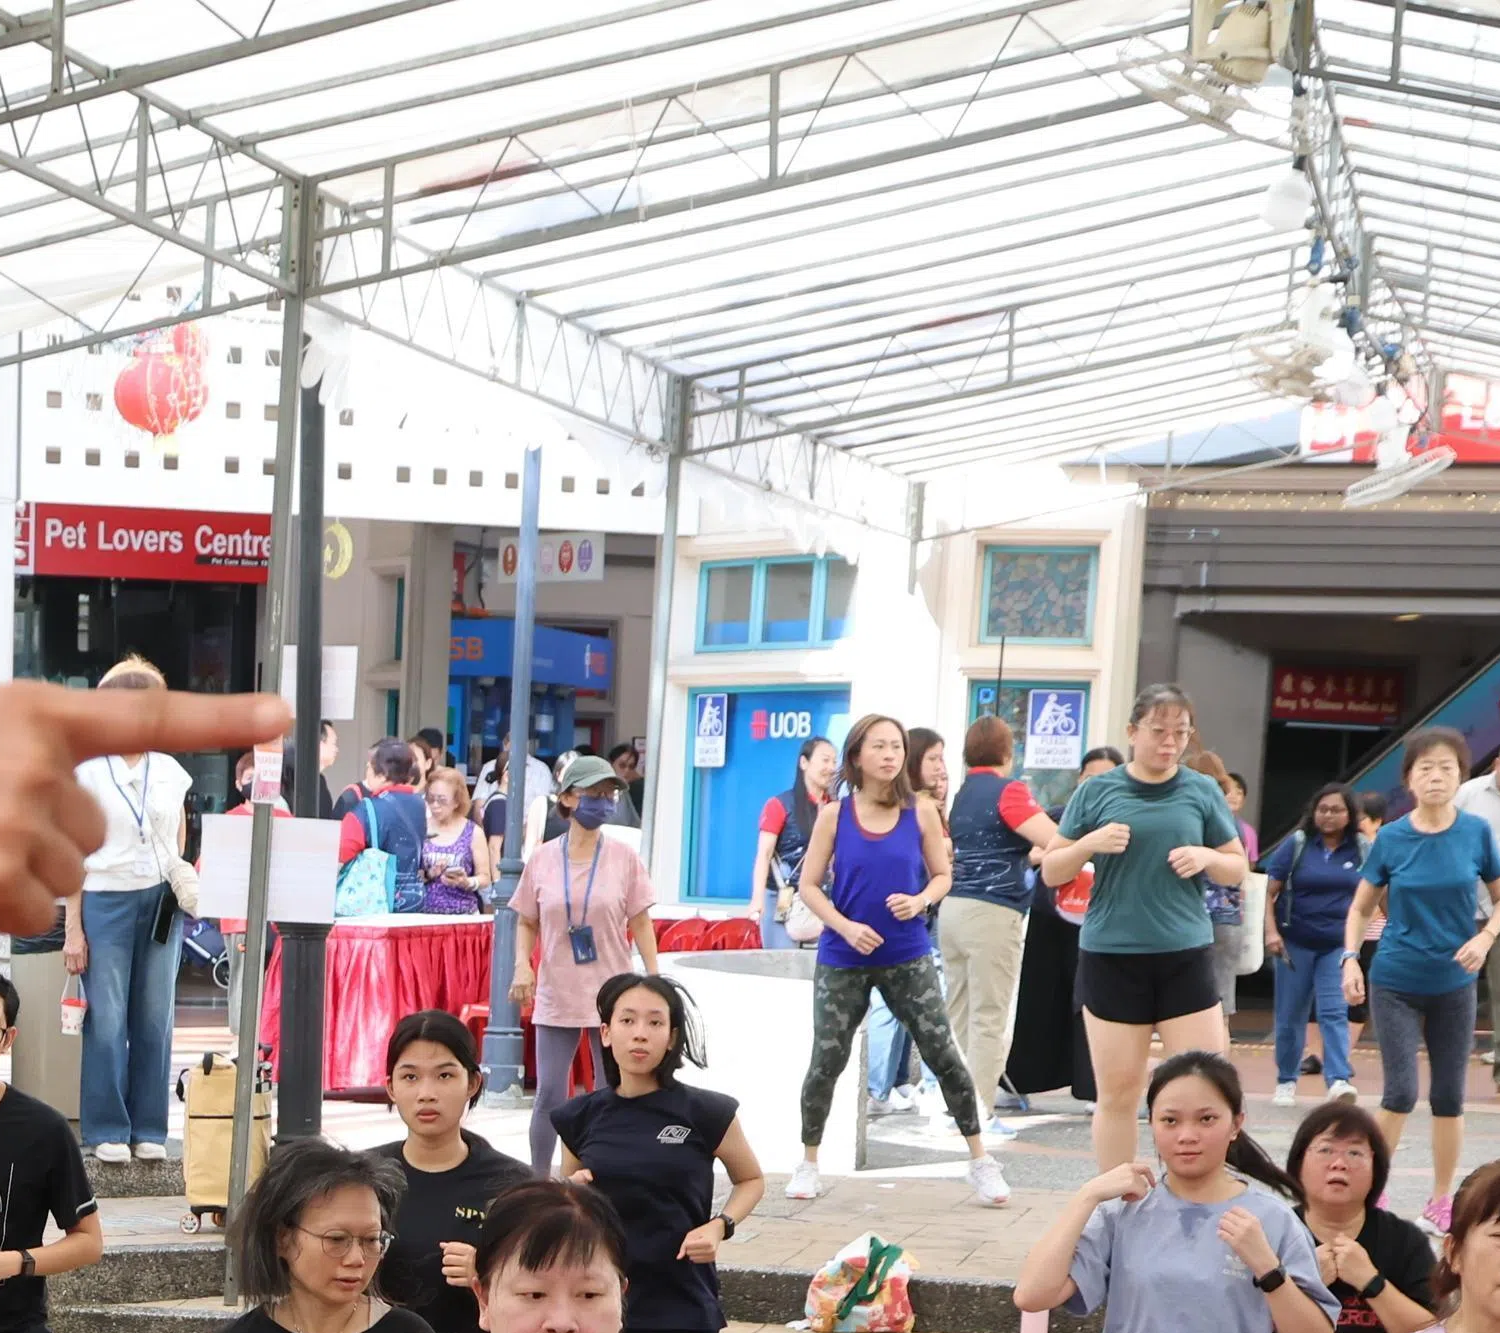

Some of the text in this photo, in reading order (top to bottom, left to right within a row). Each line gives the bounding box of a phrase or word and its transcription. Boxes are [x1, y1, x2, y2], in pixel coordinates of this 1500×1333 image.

[45, 518, 271, 557] Pet Lovers Centre
[770, 711, 811, 738] UOB
